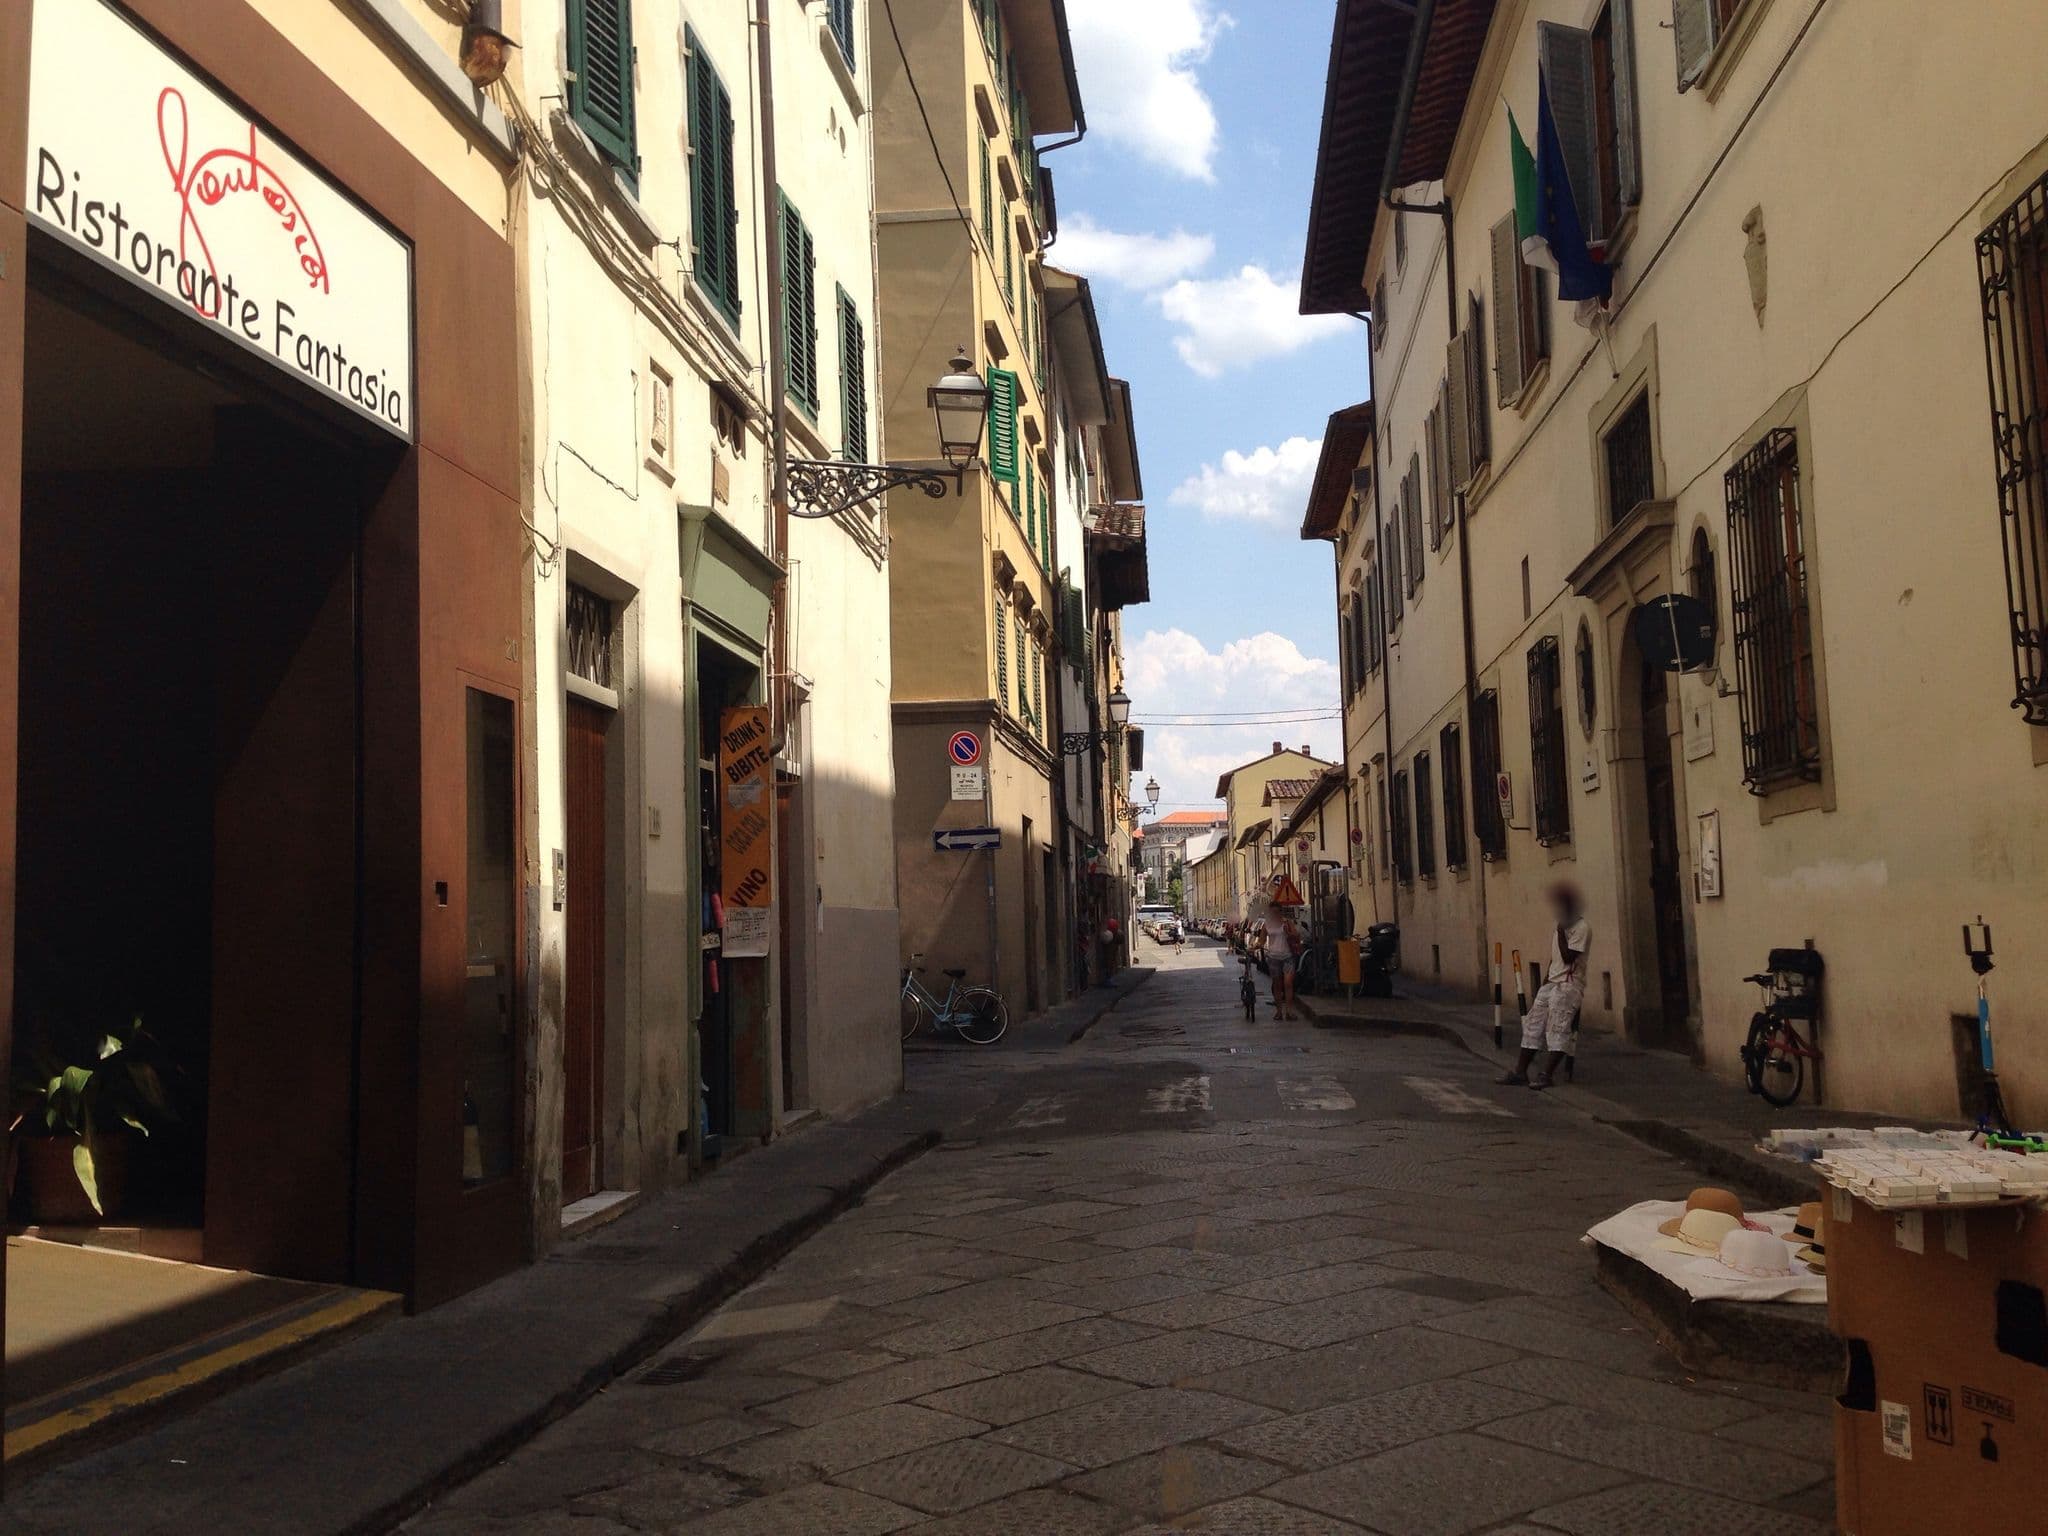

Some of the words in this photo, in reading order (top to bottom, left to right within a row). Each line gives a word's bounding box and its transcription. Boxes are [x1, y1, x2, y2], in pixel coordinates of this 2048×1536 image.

[36, 147, 262, 341] Ristorante
[274, 298, 402, 427] Fantasia
[725, 745, 769, 783] BIBITE
[729, 868, 768, 908] VINO
